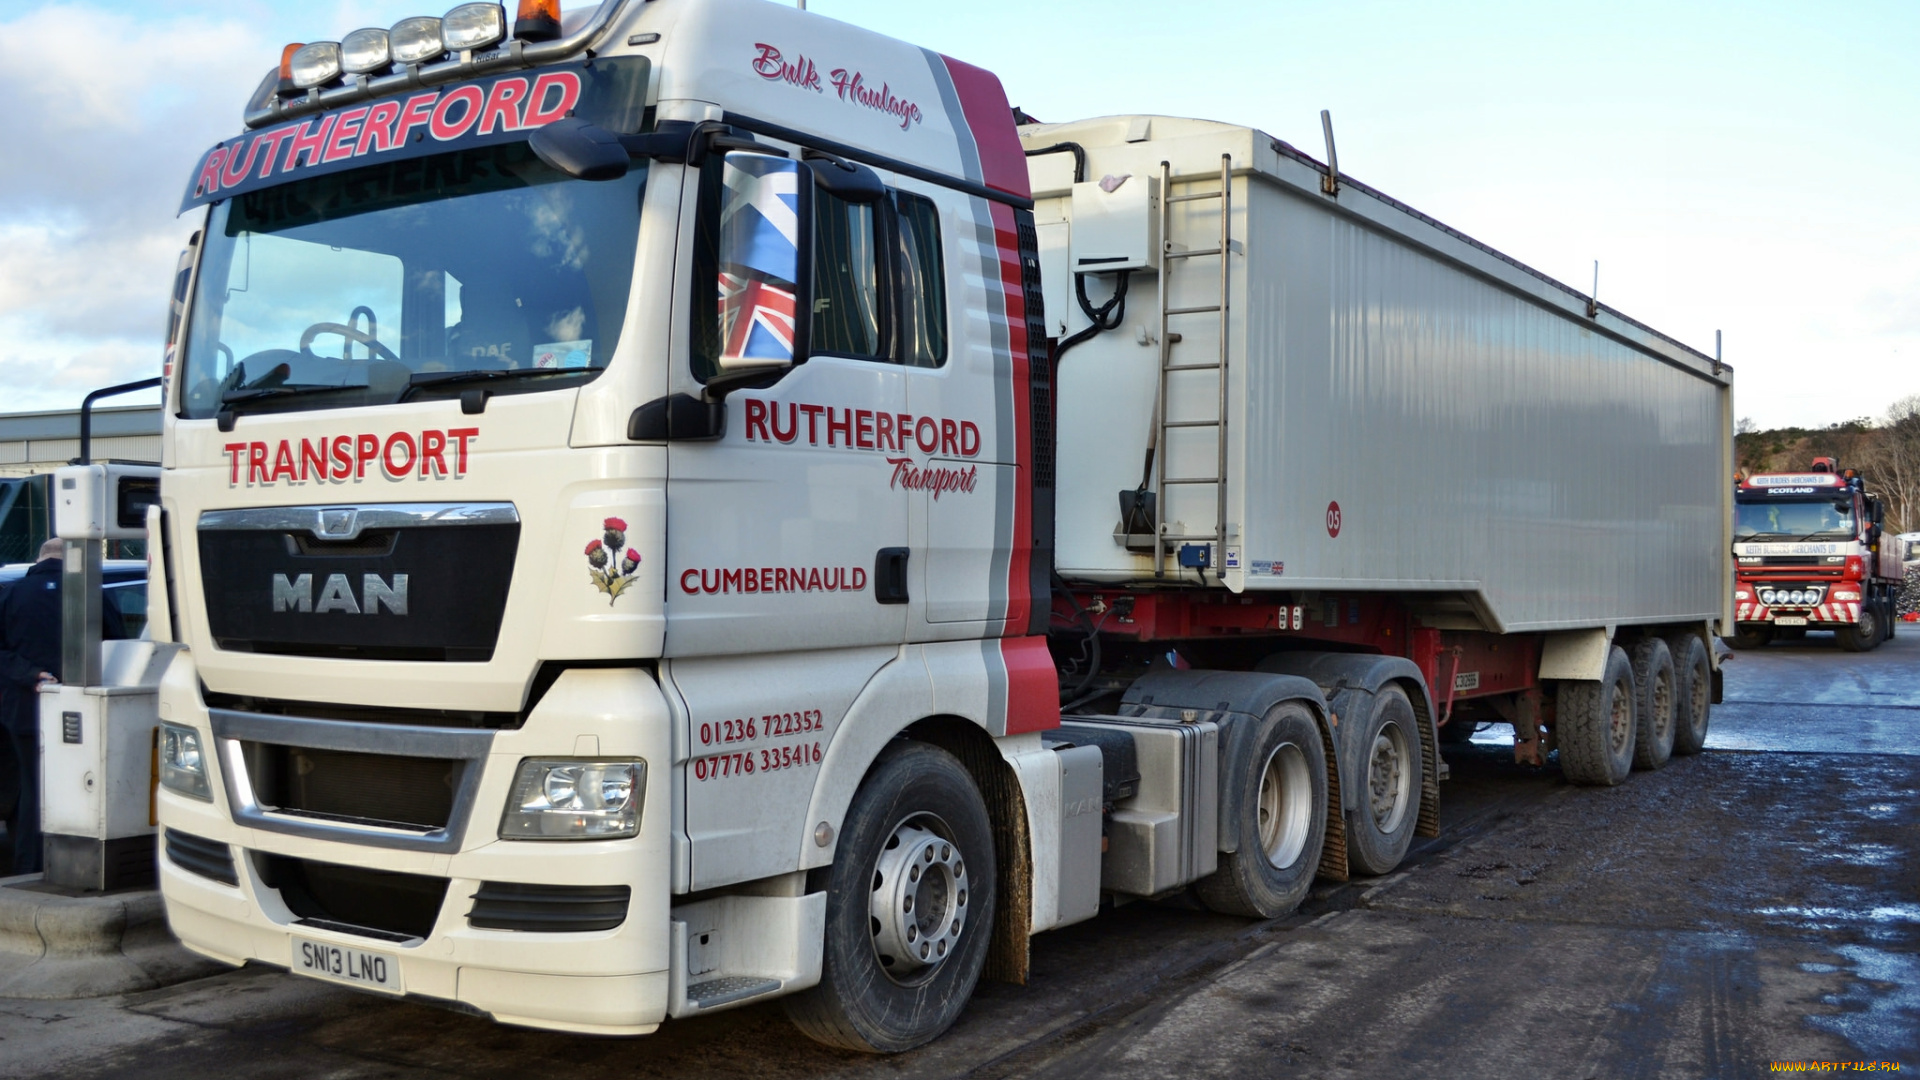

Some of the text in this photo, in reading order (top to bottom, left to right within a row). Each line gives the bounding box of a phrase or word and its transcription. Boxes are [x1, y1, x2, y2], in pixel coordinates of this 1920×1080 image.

[752, 43, 922, 130] Bulk Haulage
[194, 71, 581, 198] RUTHERFORD
[745, 398, 981, 456] RUTHERFORD
[223, 427, 480, 487] TRANSPORT
[886, 457, 977, 501] Transport
[1327, 510, 1340, 529] 05
[1745, 545, 1761, 554] KEITH
[1791, 544, 1827, 554] MERCHANTS
[273, 573, 408, 616] MAN
[680, 567, 868, 594] CUMBERNAULD
[700, 709, 823, 745] 01236 722352
[695, 742, 821, 781] 07776 335416
[302, 942, 387, 983] SN13 LNO
